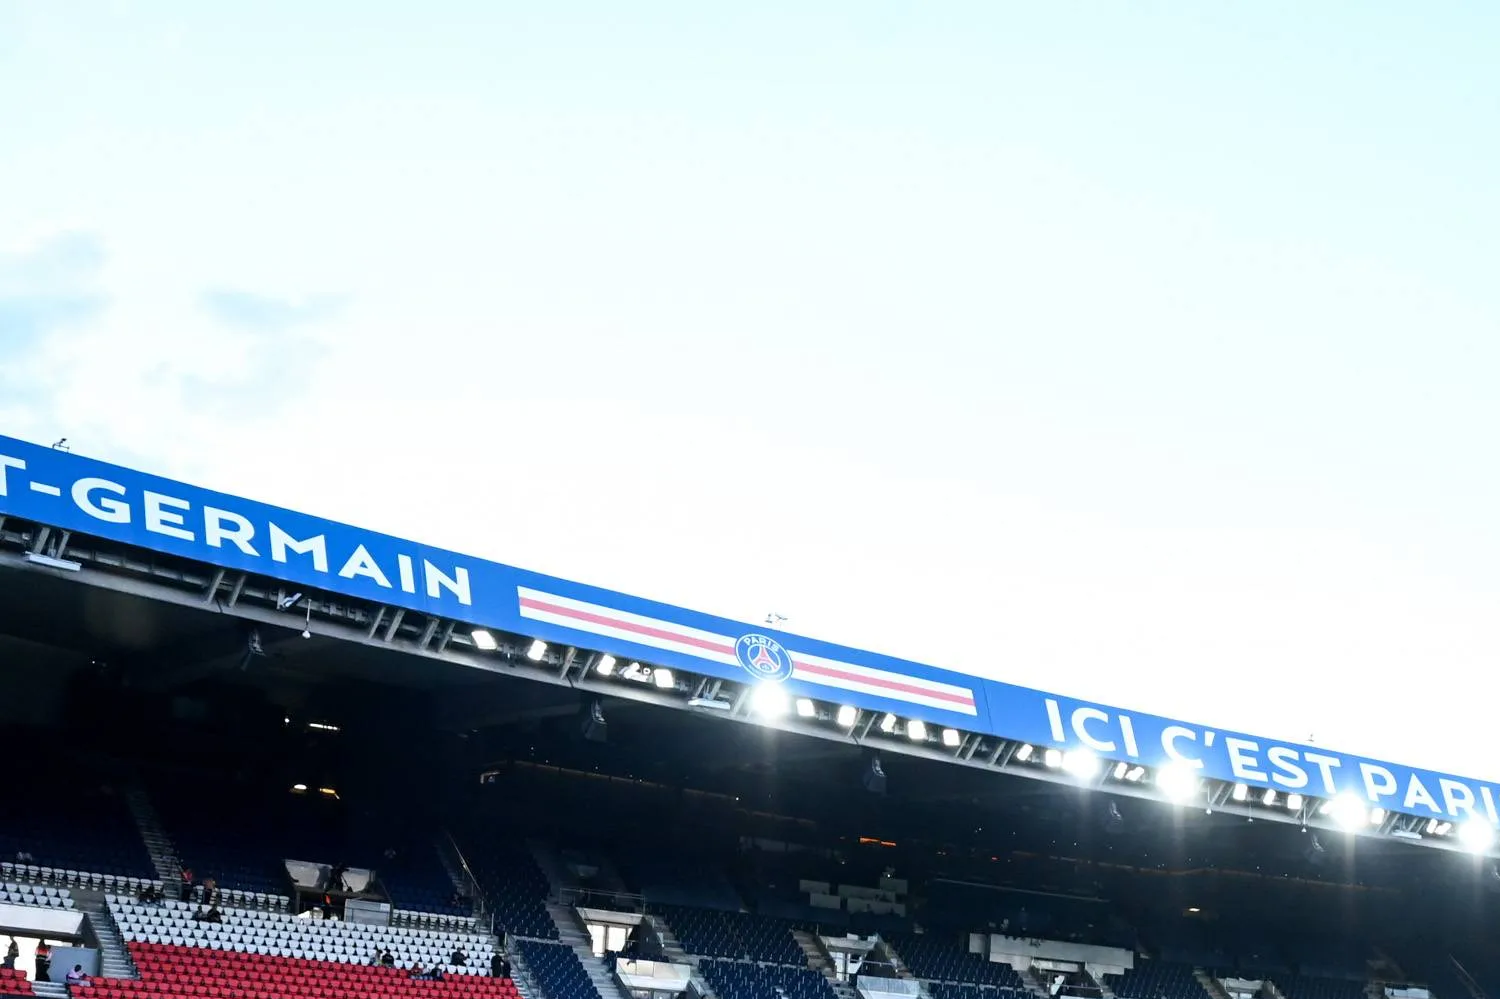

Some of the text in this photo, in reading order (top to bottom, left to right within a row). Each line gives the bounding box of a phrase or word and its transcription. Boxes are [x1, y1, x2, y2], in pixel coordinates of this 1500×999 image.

[743, 637, 779, 652] PARIS
[1044, 698, 1138, 757] ICI
[1162, 725, 1342, 790] C'EST
